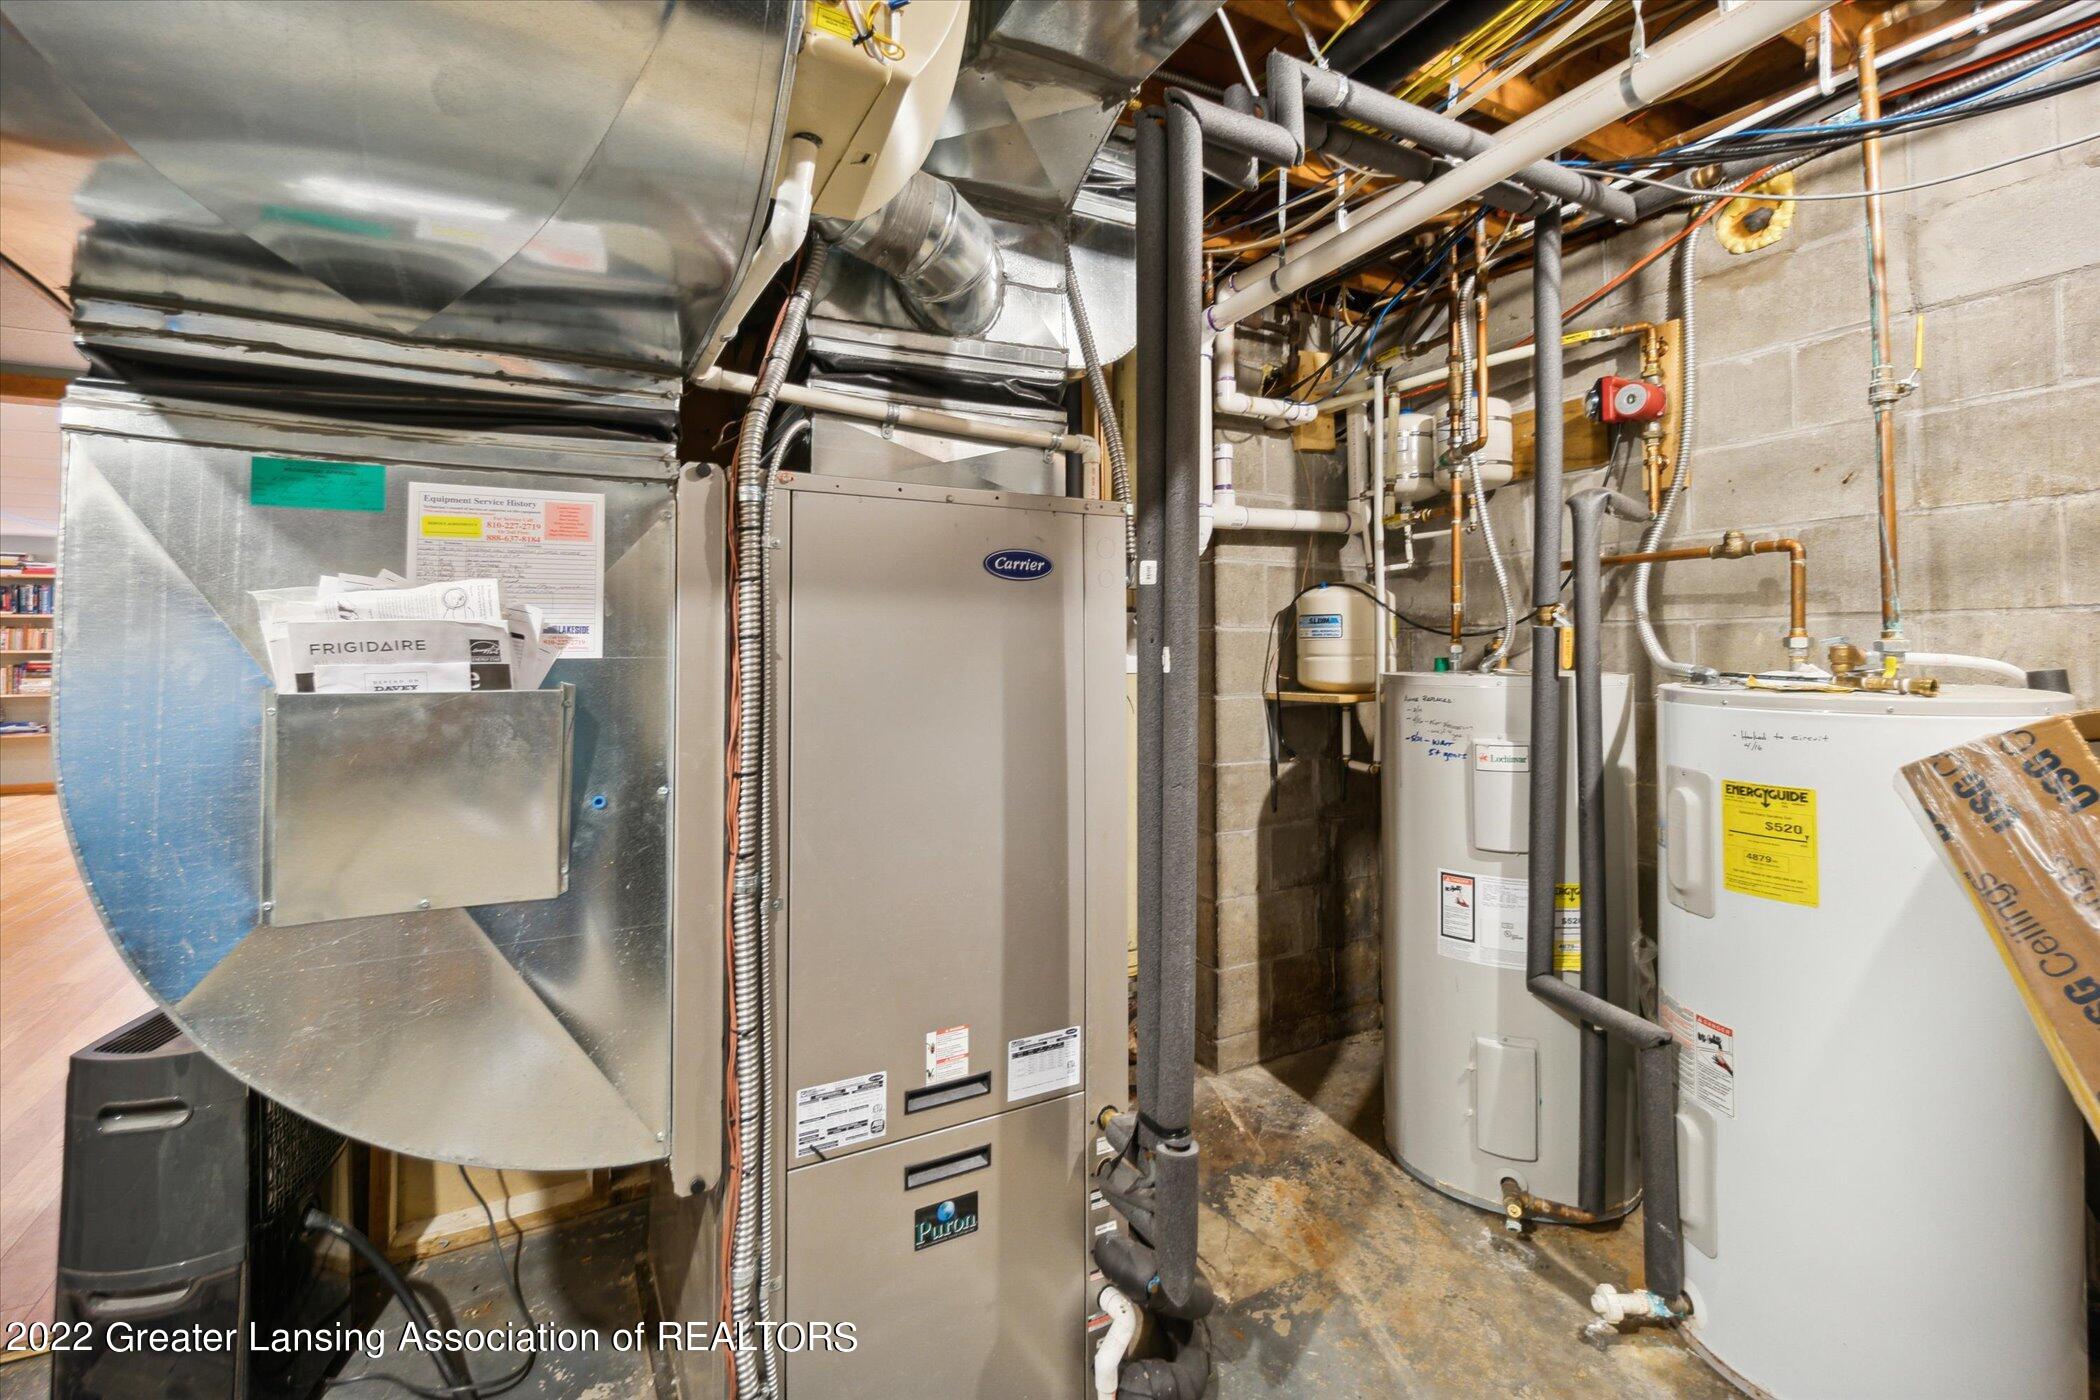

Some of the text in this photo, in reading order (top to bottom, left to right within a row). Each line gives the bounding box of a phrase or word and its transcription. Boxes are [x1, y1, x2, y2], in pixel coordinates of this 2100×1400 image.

[423, 495, 537, 509] Equipment Service History
[994, 557, 1045, 571] Carrier
[559, 625, 590, 634] LAKESIDE
[309, 640, 427, 655] FRIGIDAIRE
[373, 684, 419, 692] DAVEY
[2023, 748, 2099, 815] USG
[1725, 783, 1808, 804] ENERGYGUIDE
[1745, 852, 1772, 863] 4879
[915, 1214, 977, 1247] Puron
